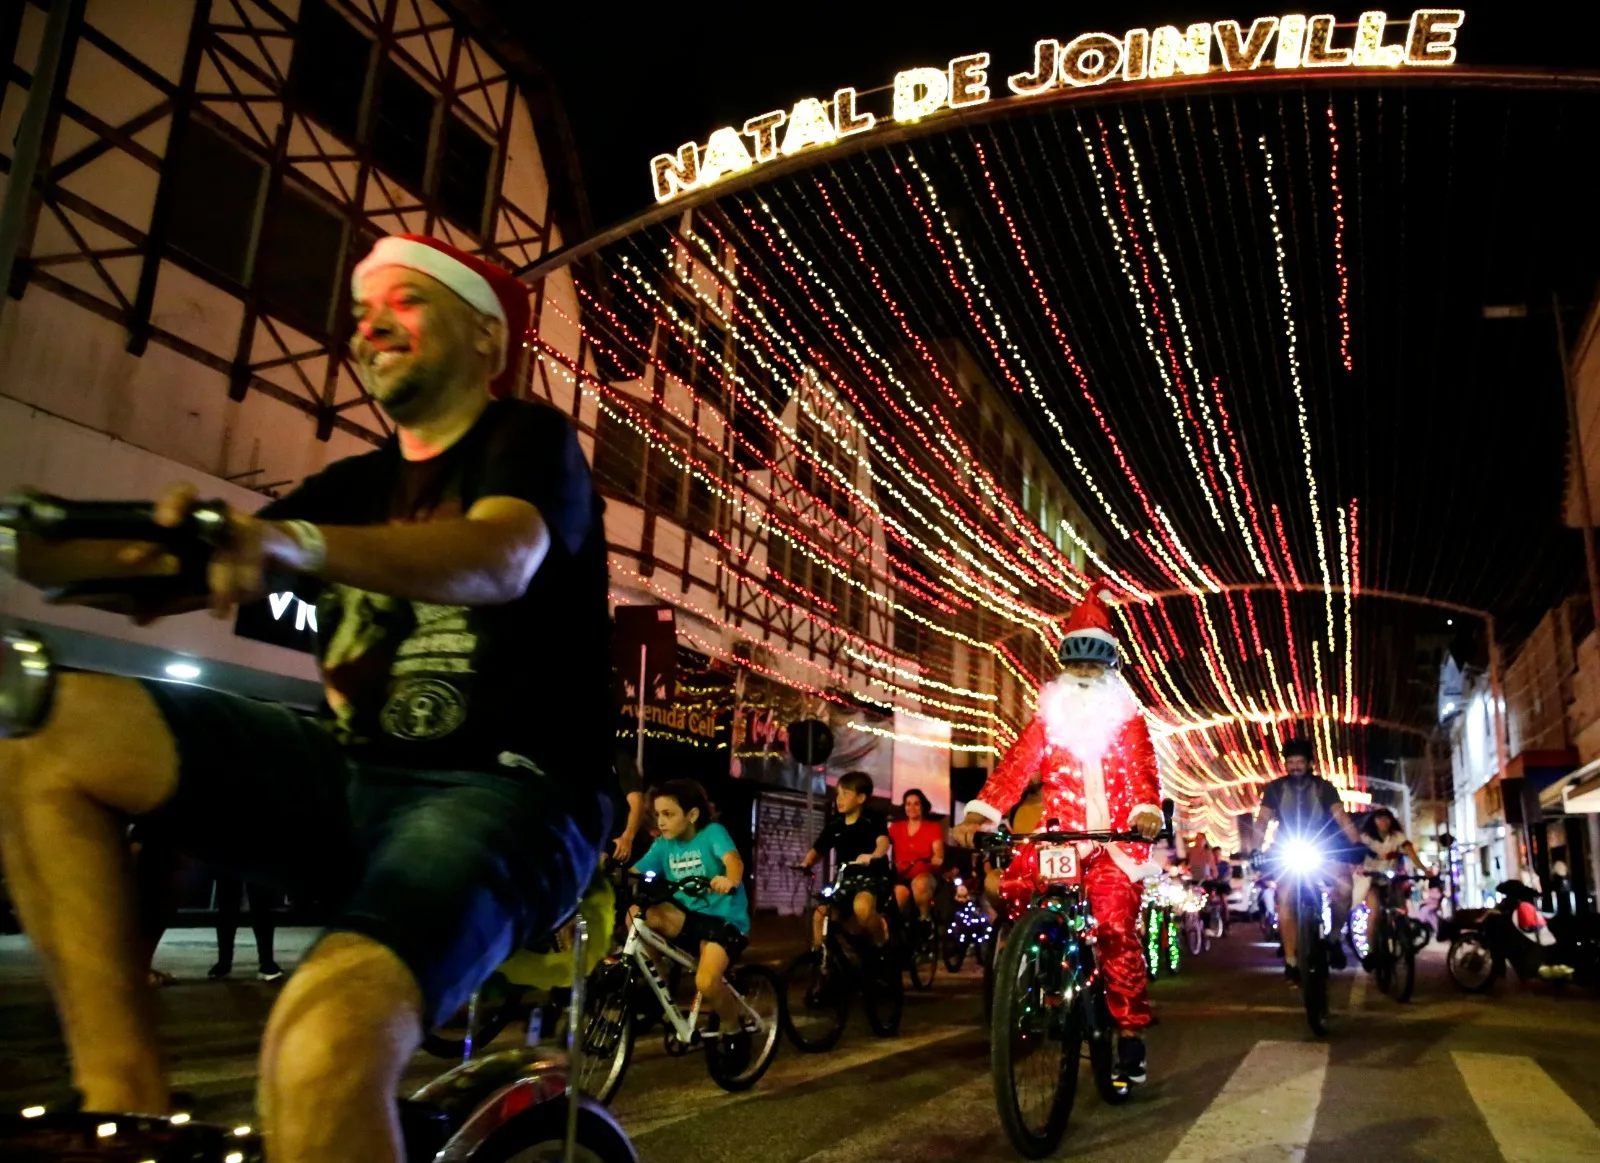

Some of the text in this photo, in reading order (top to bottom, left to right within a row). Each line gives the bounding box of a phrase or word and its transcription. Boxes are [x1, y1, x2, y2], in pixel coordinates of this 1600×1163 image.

[651, 9, 1465, 203] NATAL DE JOINVILLE
[1045, 856, 1071, 874] 18
